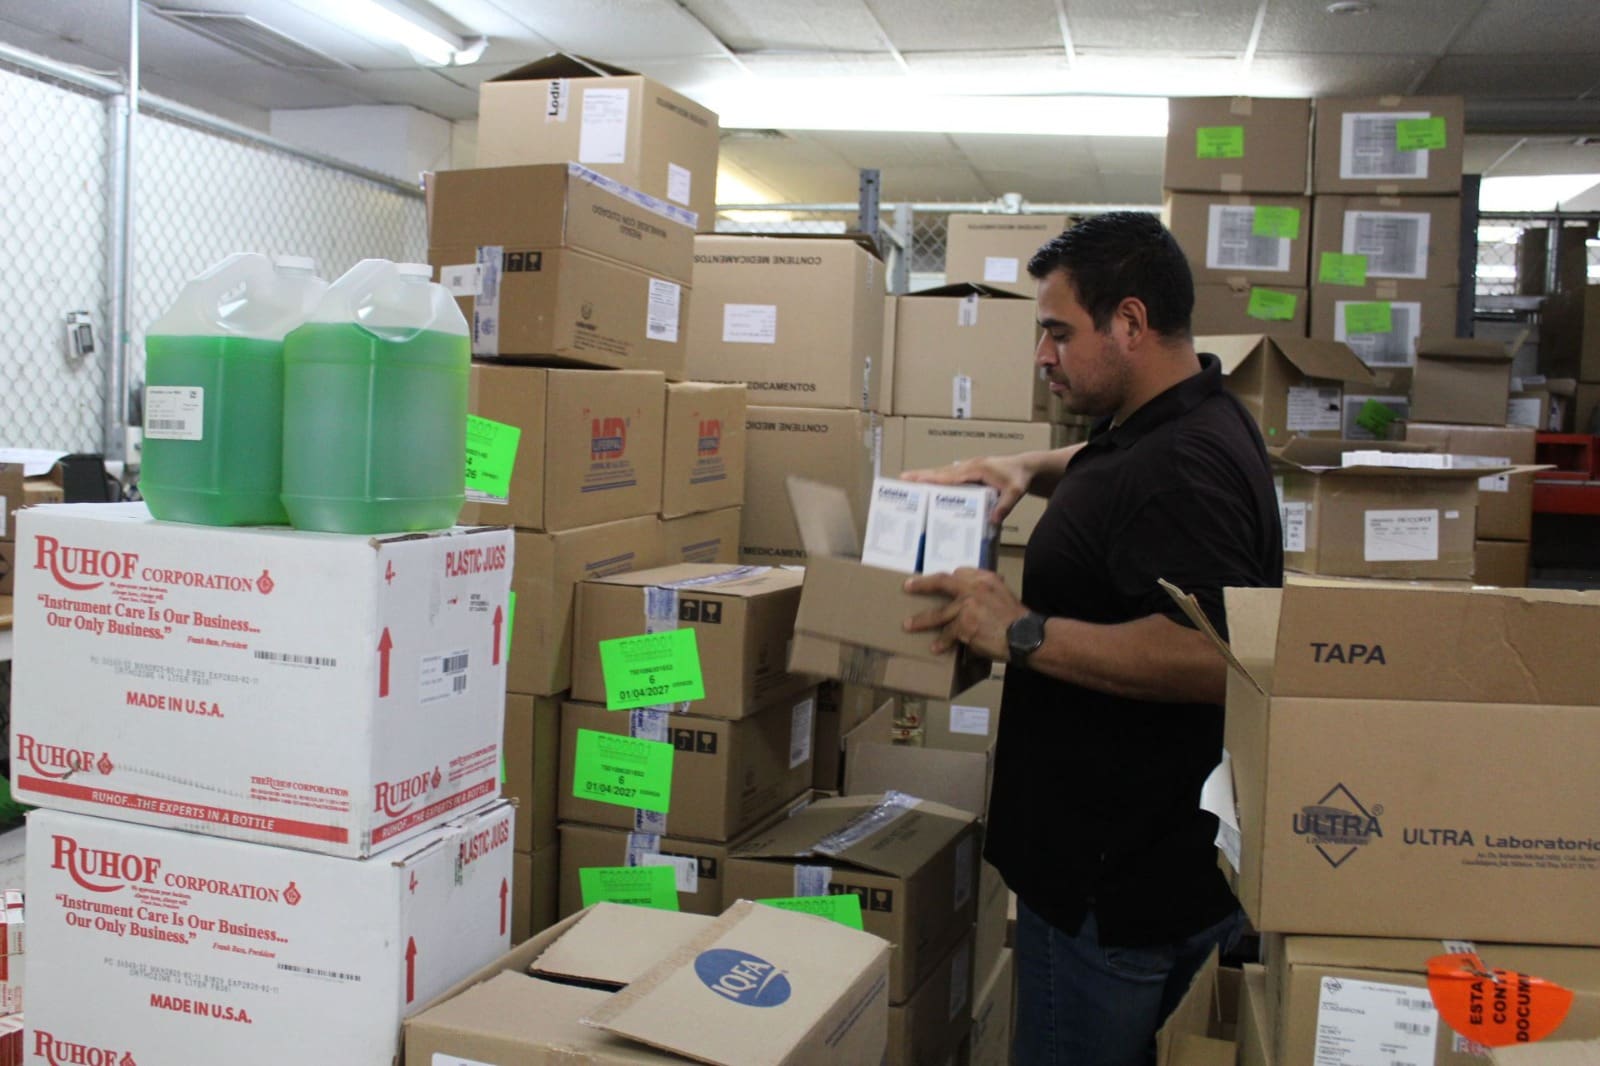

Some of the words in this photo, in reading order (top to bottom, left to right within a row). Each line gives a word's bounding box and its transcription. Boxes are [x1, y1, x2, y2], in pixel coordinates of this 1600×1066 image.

[694, 254, 770, 264] MEDICAMENTOS
[773, 255, 822, 265] CONTIENE
[591, 416, 626, 461] MD
[779, 422, 828, 433] CONTIENE
[33, 535, 139, 590] RUHOF
[142, 567, 253, 592] CORPORATION
[385, 560, 396, 585] 4
[446, 549, 481, 578] PLASTIC
[483, 545, 506, 571] JUGS
[46, 612, 72, 629] Our
[74, 615, 104, 636] Only
[114, 602, 145, 620] Care
[148, 607, 161, 622] Is
[163, 608, 190, 626] Our
[193, 611, 261, 633] Business...
[1310, 643, 1386, 665] TAPA
[619, 684, 669, 701] 01/04/2027
[649, 675, 656, 684] 6
[126, 691, 166, 711] MADE
[168, 697, 184, 713] IN
[185, 699, 225, 718] U.S.A.
[17, 734, 94, 779] RUHOF
[292, 782, 349, 797] CORPORATION
[585, 781, 636, 798] 01/04/2027
[618, 775, 625, 785] 6
[374, 771, 430, 818] RUHOF
[159, 803, 204, 818] EXPERTS
[207, 810, 218, 820] IN
[222, 812, 230, 823] A
[232, 814, 274, 830] BOTTLE
[1292, 814, 1383, 838] ULTRA
[1403, 828, 1474, 846] ULTRA
[51, 835, 161, 893] RUHOF
[164, 873, 279, 902] CORPORATION
[409, 870, 418, 894] 4
[491, 818, 509, 850] JUGS
[65, 912, 93, 929] Our
[95, 917, 127, 937] Only
[136, 906, 169, 924] Care
[172, 912, 184, 926] Is
[187, 914, 216, 933] Our
[218, 919, 289, 944] Business...
[711, 960, 773, 999] IQFA
[150, 993, 191, 1013] MADE
[193, 1000, 209, 1016] IN
[211, 1003, 252, 1024] U.S.A.
[1470, 982, 1484, 1025] ESTA
